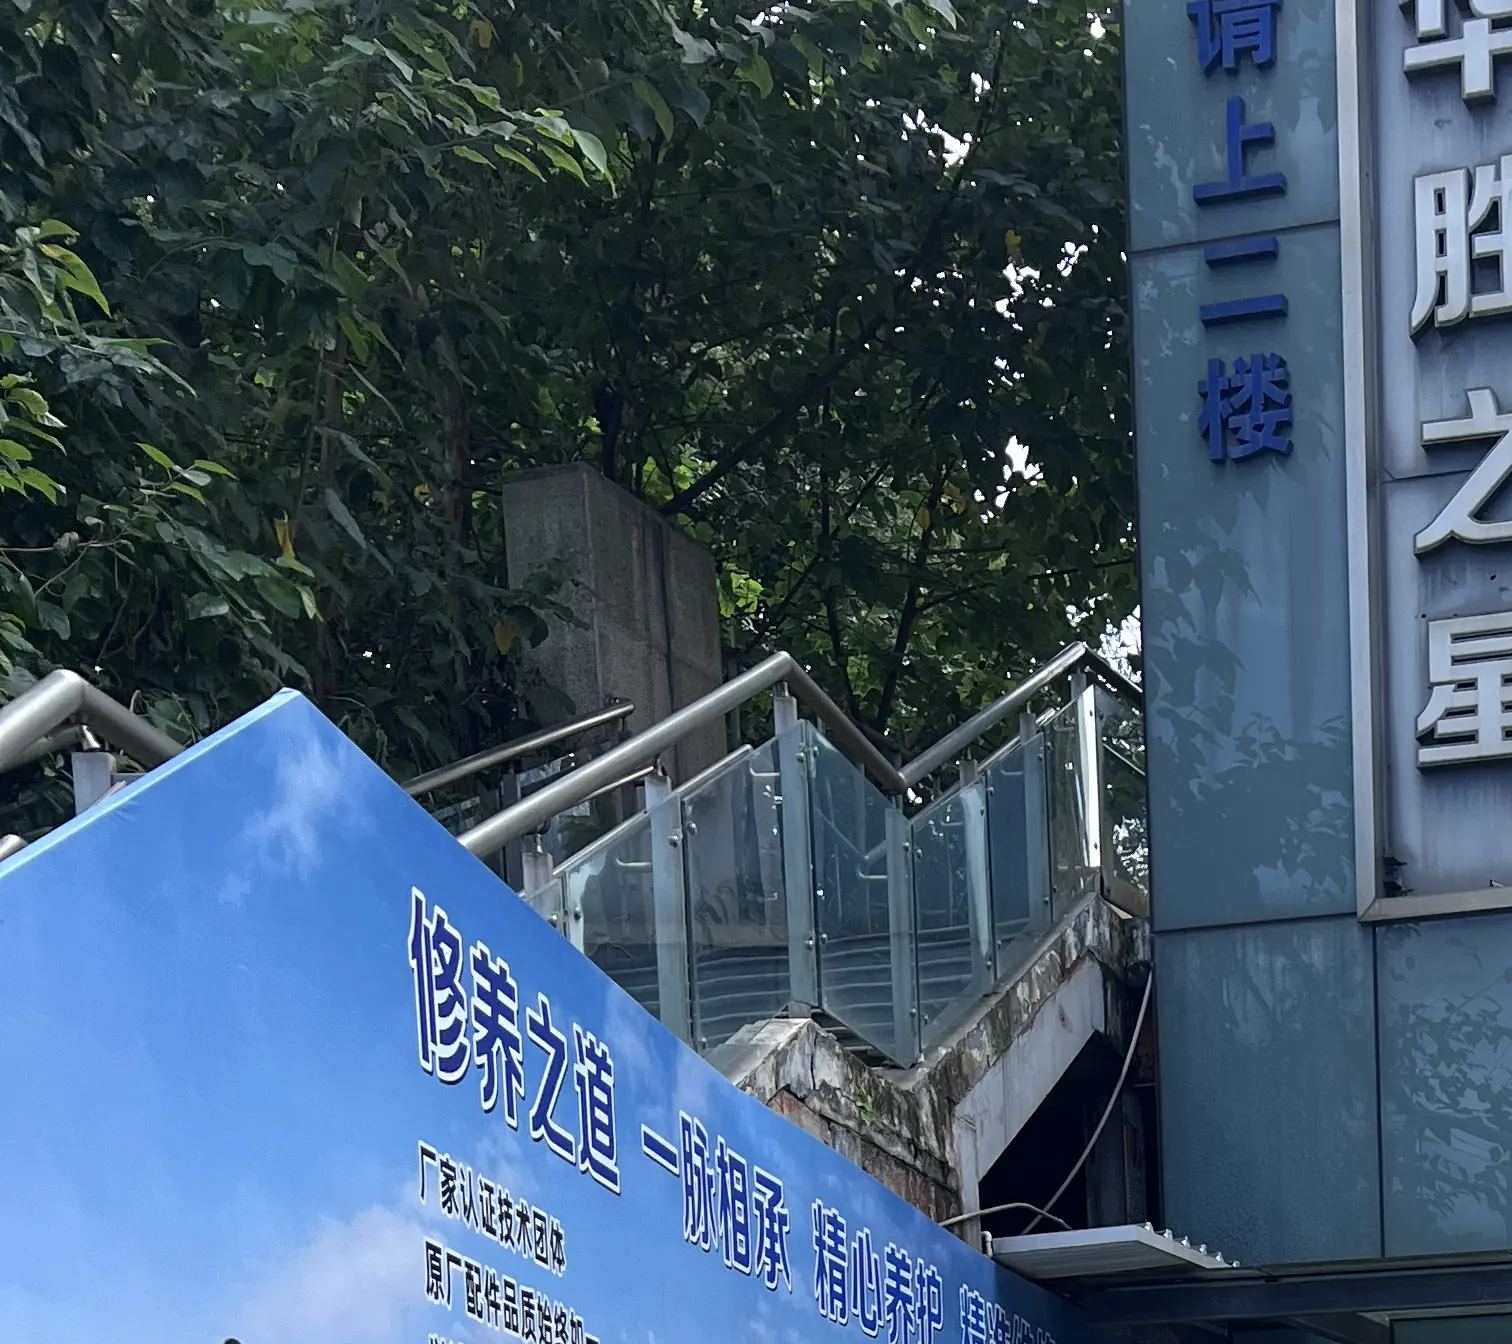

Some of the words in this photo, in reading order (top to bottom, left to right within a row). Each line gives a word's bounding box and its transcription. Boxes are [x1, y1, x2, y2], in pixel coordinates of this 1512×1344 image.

[1187, 0, 1293, 464] 请上二楼
[407, 886, 621, 1196] 修养之道
[640, 1109, 793, 1293] 一脉相承
[418, 1139, 567, 1277] 厂家认证技术团体
